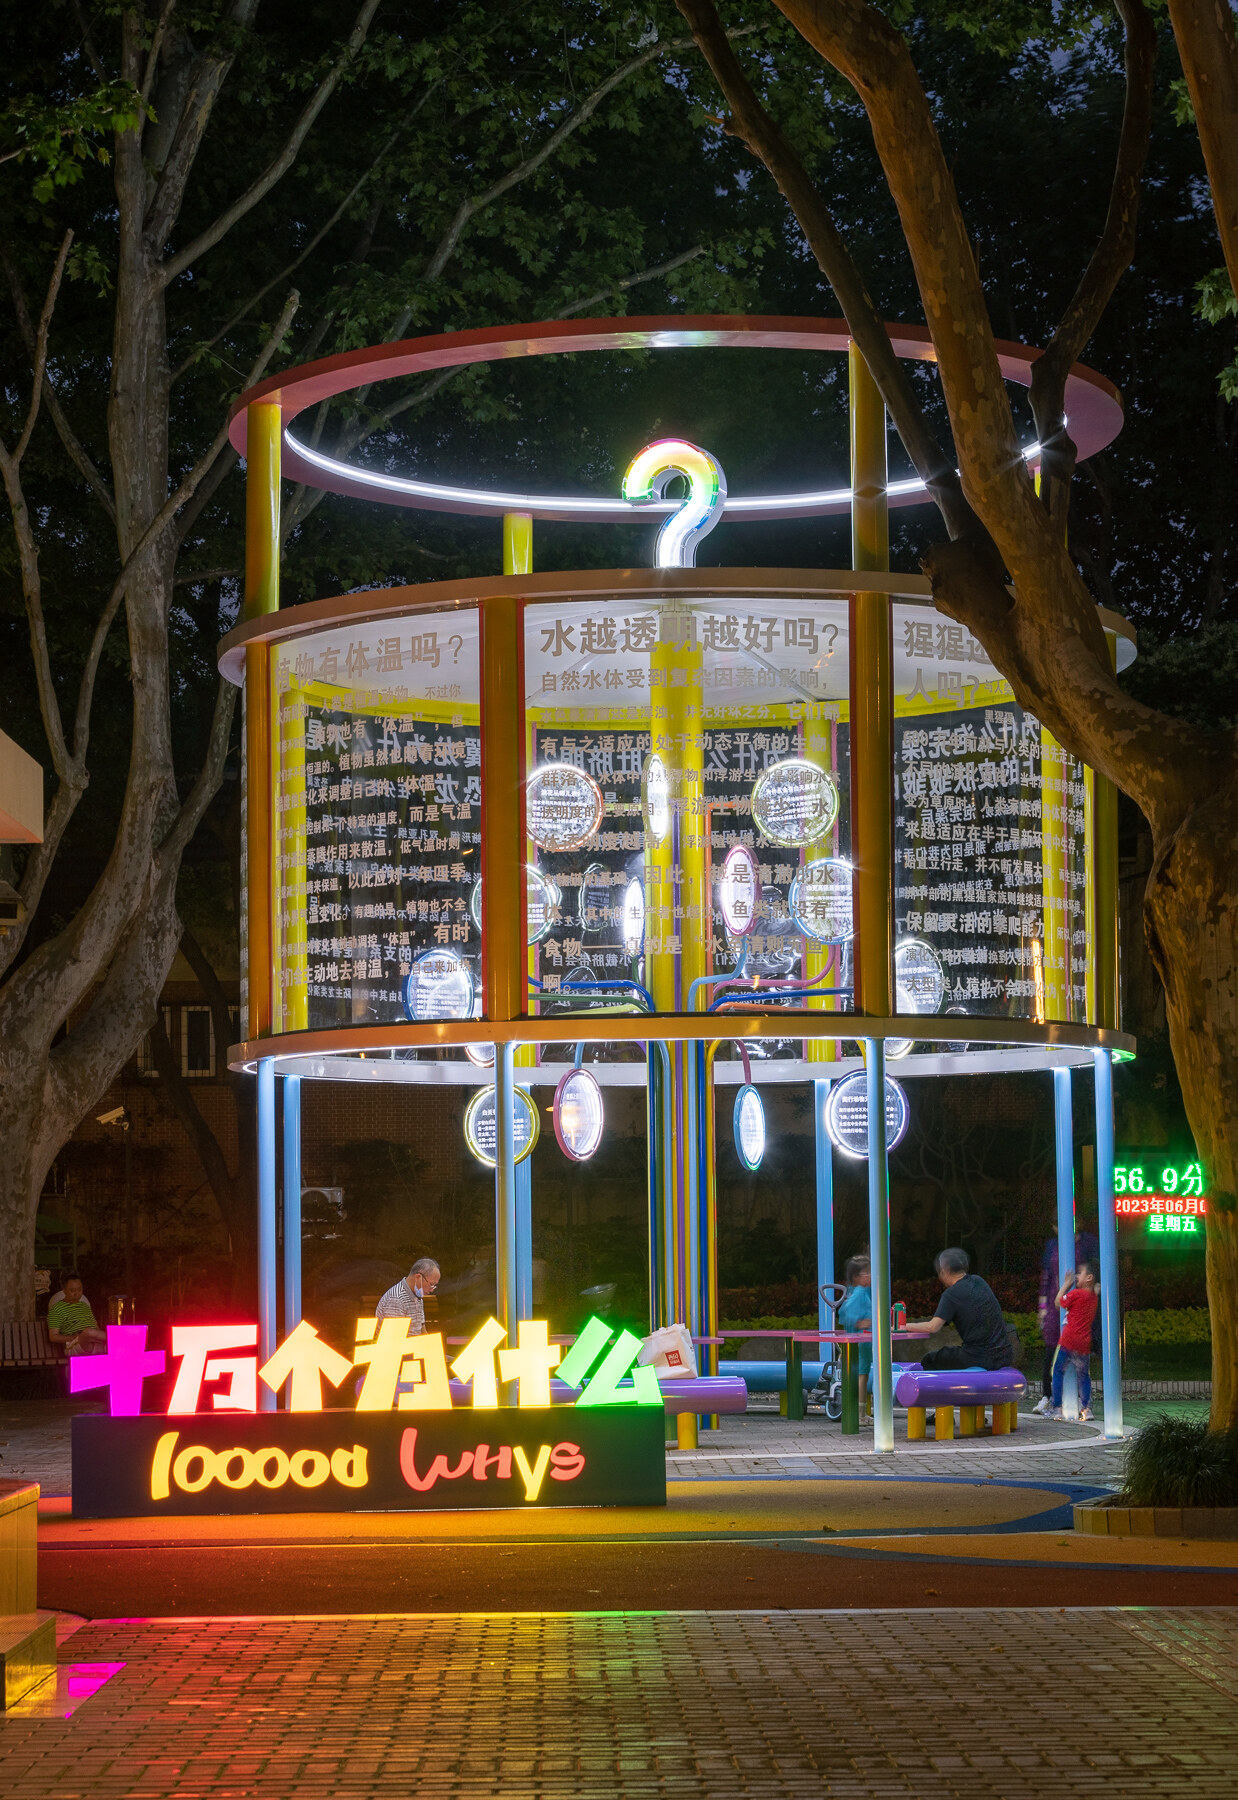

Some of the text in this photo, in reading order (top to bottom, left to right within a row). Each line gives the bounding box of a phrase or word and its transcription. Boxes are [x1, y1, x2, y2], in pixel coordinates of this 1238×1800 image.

[540, 615, 839, 656] 水越透明越好吗?
[275, 631, 463, 696] 植物有体温吗?
[1149, 1215, 1197, 1232] 星期五
[70, 1315, 665, 1416] 十万个为什么
